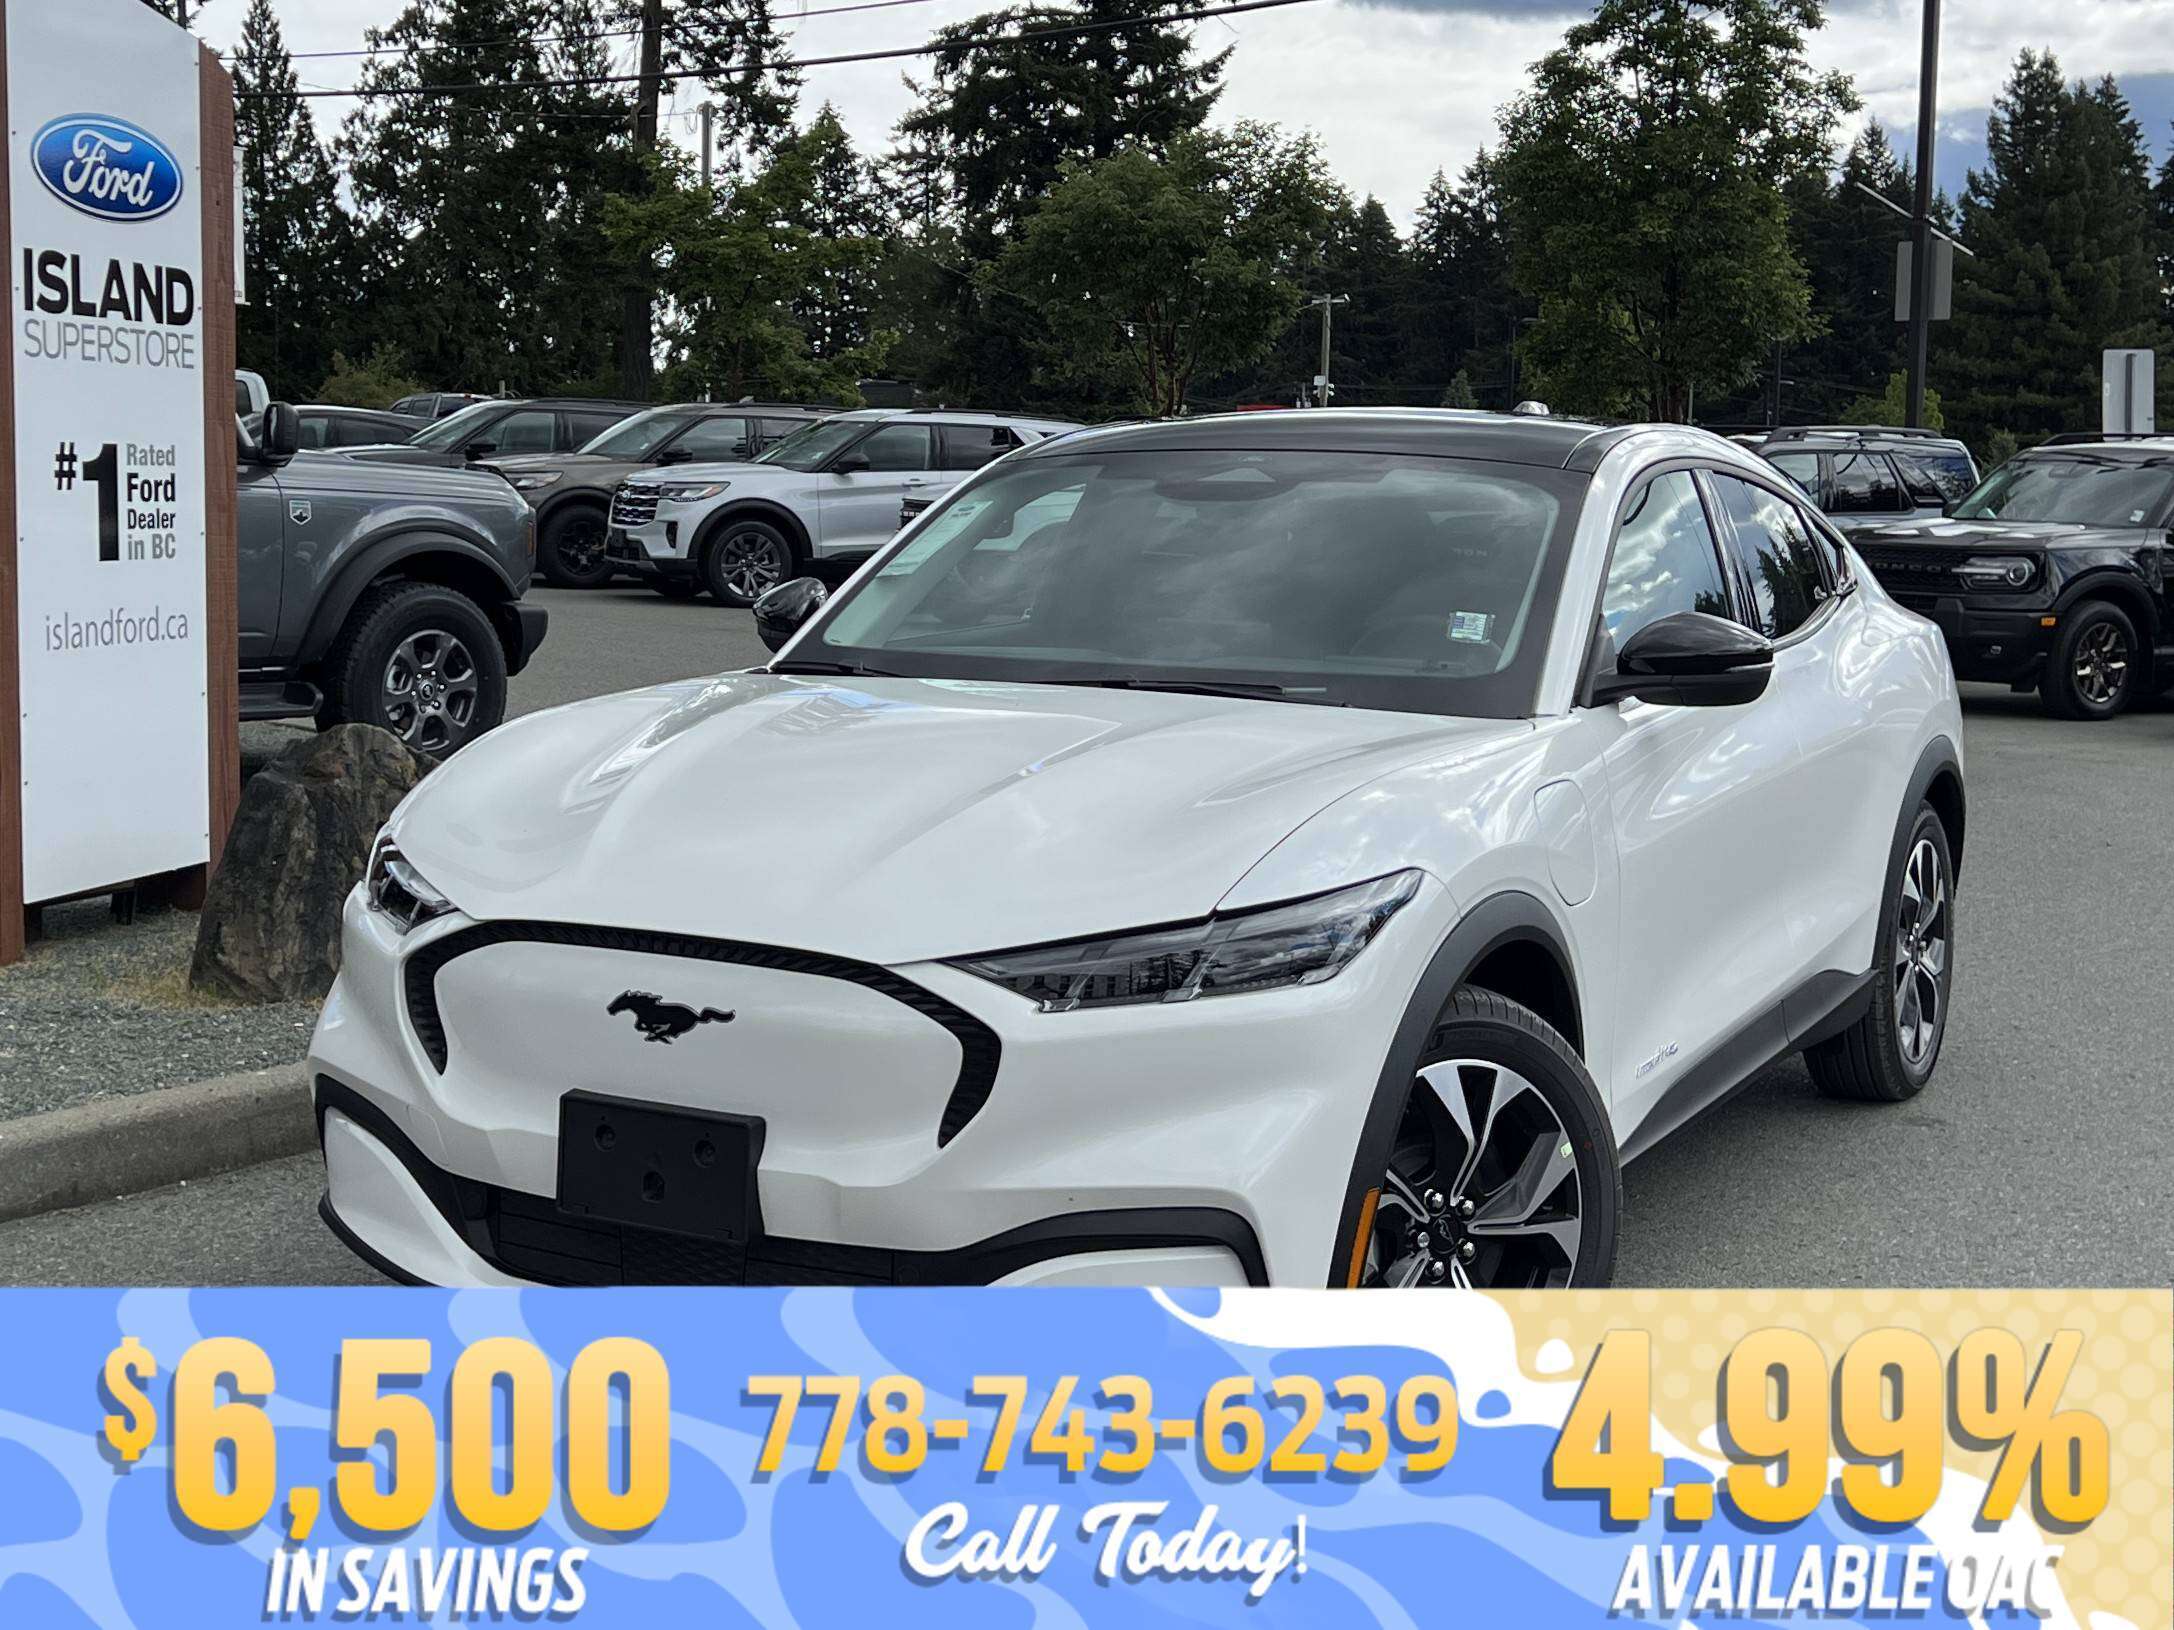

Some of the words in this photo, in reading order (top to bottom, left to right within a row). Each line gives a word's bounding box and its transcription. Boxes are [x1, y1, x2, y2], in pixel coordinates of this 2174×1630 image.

[62, 128, 156, 207] Ford
[23, 247, 195, 326] ISLAND
[23, 318, 195, 369] SUPERSTORE
[126, 444, 176, 466] Rated
[54, 441, 120, 562] #1
[126, 472, 176, 502] Ford
[126, 508, 176, 530] Dealer
[127, 535, 145, 560] in
[151, 533, 176, 560] BC
[45, 606, 189, 651] islandford.ca
